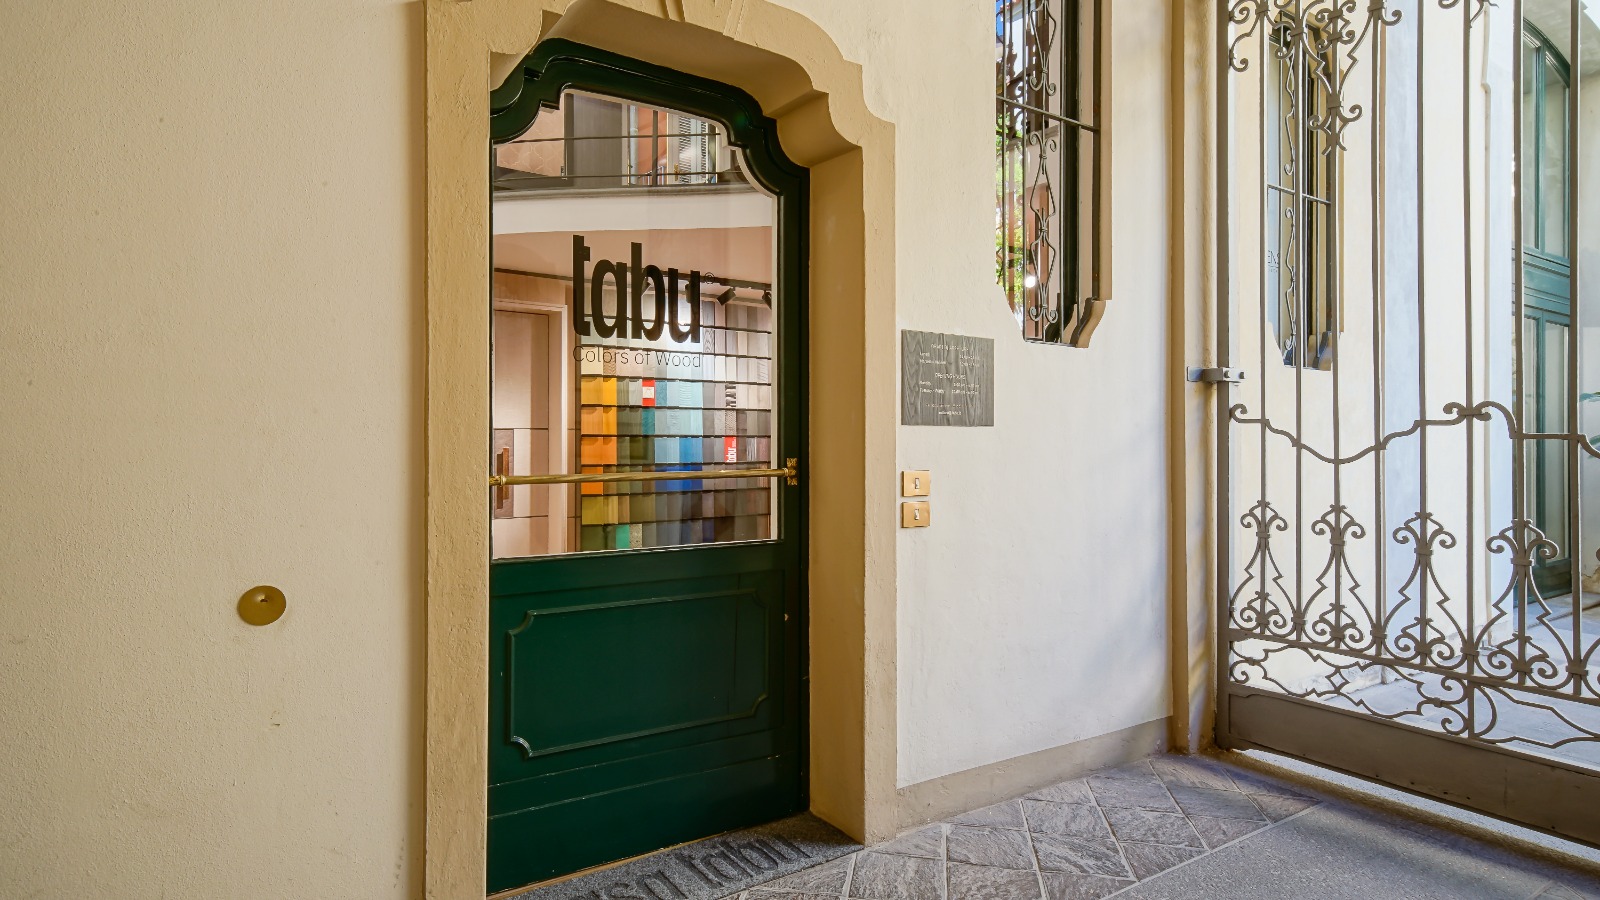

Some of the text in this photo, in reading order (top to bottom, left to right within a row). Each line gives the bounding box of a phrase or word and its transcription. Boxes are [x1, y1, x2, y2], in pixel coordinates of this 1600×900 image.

[572, 234, 701, 344] tabu
[573, 345, 701, 368] Colors of Wood
